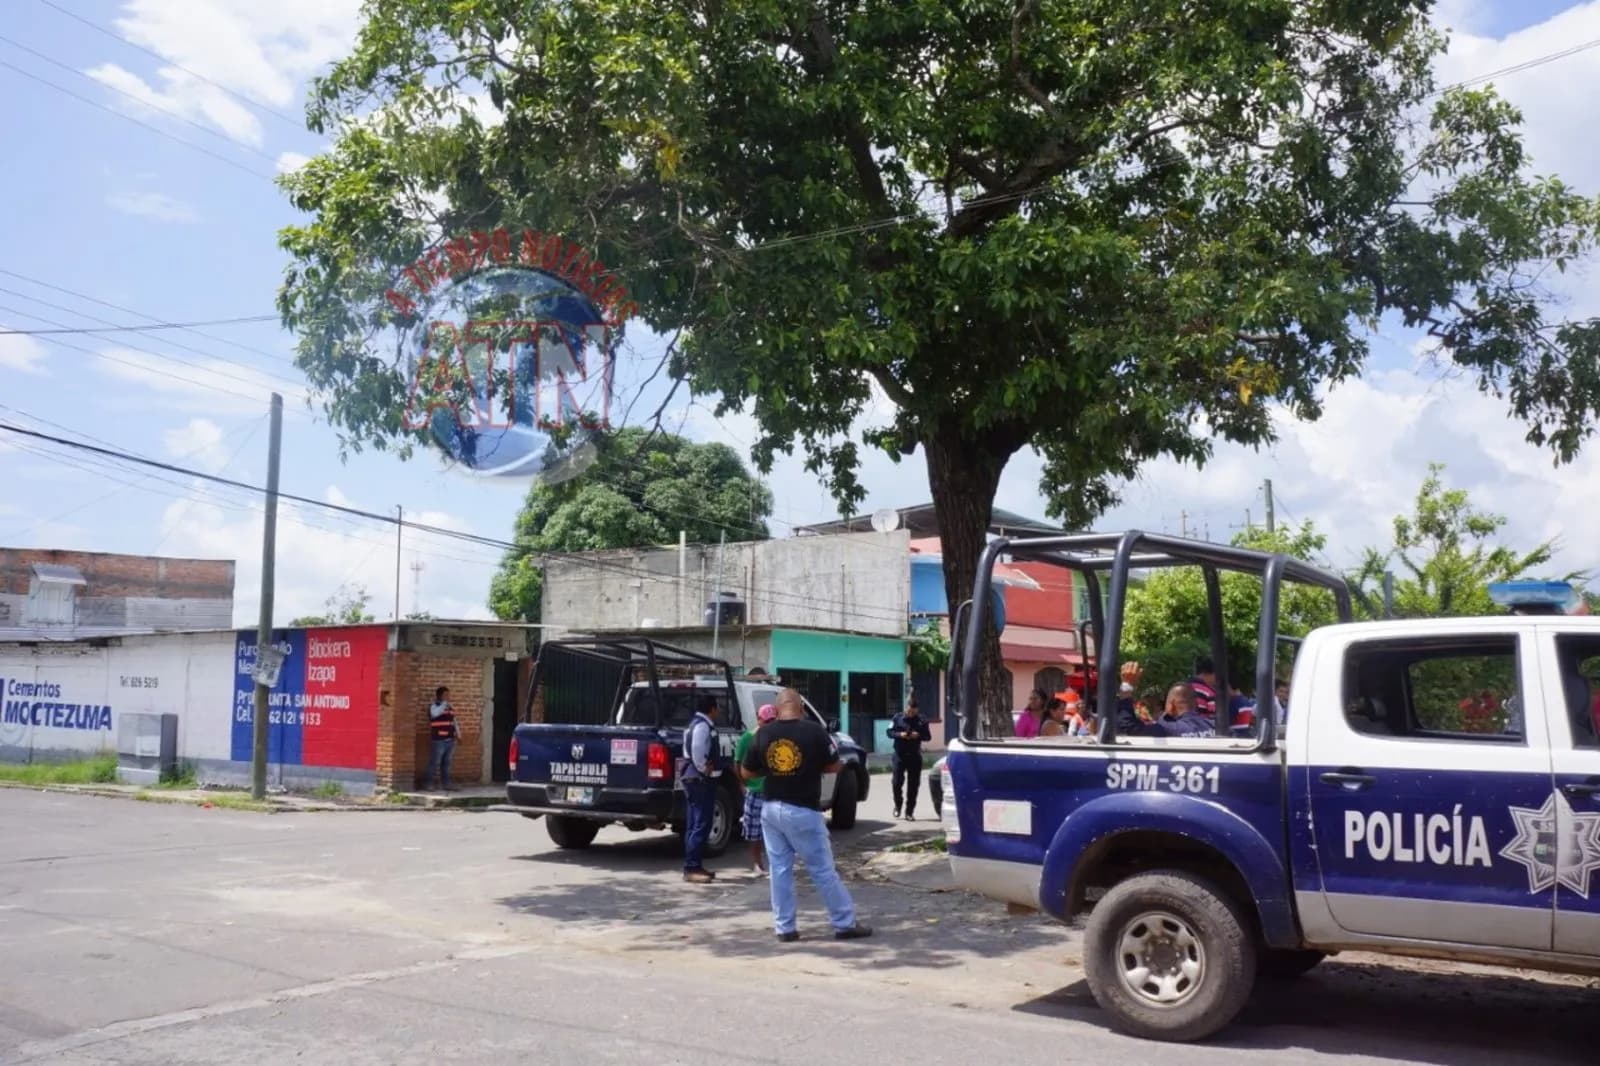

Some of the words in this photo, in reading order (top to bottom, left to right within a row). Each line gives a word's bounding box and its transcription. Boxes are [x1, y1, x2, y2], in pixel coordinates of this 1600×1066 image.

[309, 638, 351, 658] Blockera
[308, 662, 336, 687] Izapa
[8, 678, 61, 698] Cementos
[295, 694, 312, 708] SAN
[4, 700, 112, 731] MOCTEZUMA
[549, 761, 608, 777] TAPACHULA
[1105, 762, 1220, 794] SPM-361
[575, 775, 608, 785] MUNICIPAL
[1343, 803, 1493, 868] POLICÍA
